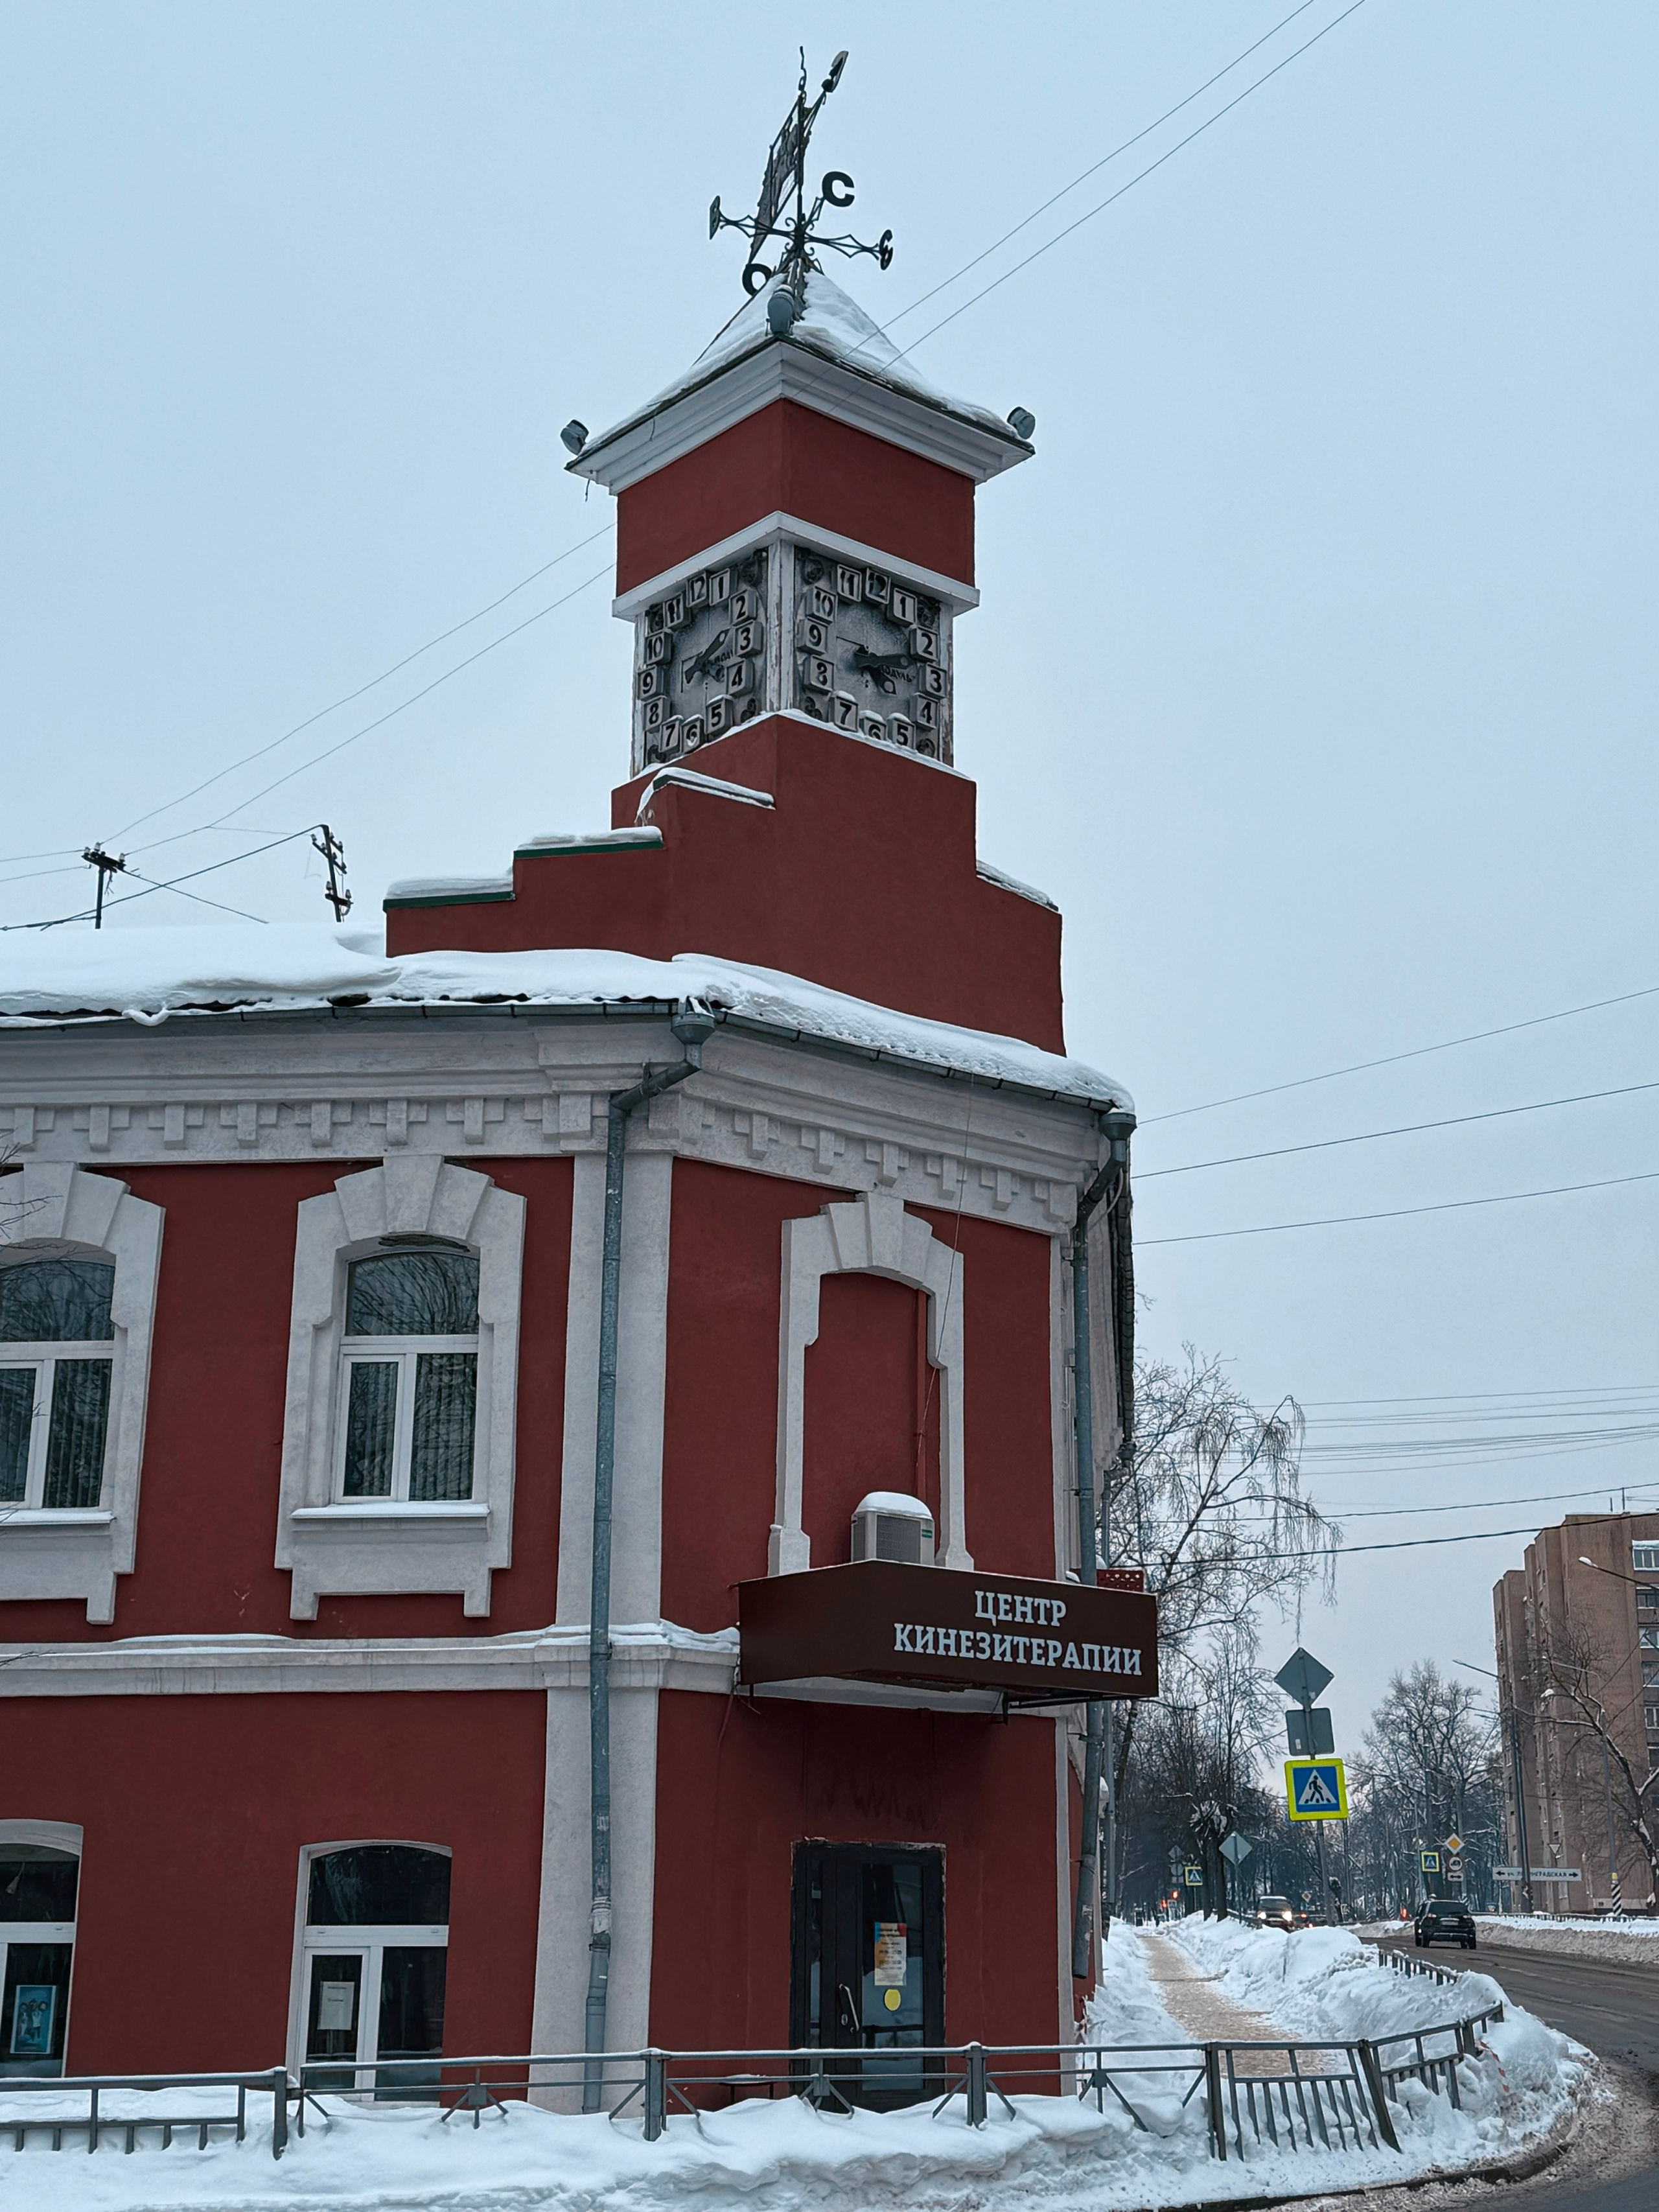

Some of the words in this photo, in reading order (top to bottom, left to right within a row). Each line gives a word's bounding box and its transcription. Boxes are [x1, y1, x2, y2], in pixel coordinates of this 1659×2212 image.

[690, 576, 706, 603] 12
[718, 576, 724, 600] 1
[840, 570, 857, 597] 11
[868, 572, 887, 597] 12
[736, 595, 746, 620] 2
[815, 590, 834, 617] 10
[899, 594, 907, 618] 1
[649, 636, 663, 658] 10
[739, 627, 751, 651] 3
[809, 624, 822, 647] 9
[921, 633, 934, 657] 2
[642, 671, 653, 695] 9
[732, 664, 743, 687] 4
[930, 670, 943, 693] 3
[649, 702, 660, 725] 8
[711, 704, 723, 727] 5
[840, 701, 852, 725] 7
[922, 701, 933, 725] 4
[665, 724, 676, 747] 7
[896, 723, 909, 746] 5
[975, 1590, 1066, 1627] ЦЕНТР
[894, 1623, 1142, 1676] КИНЕЗИТЕРАПИИ
